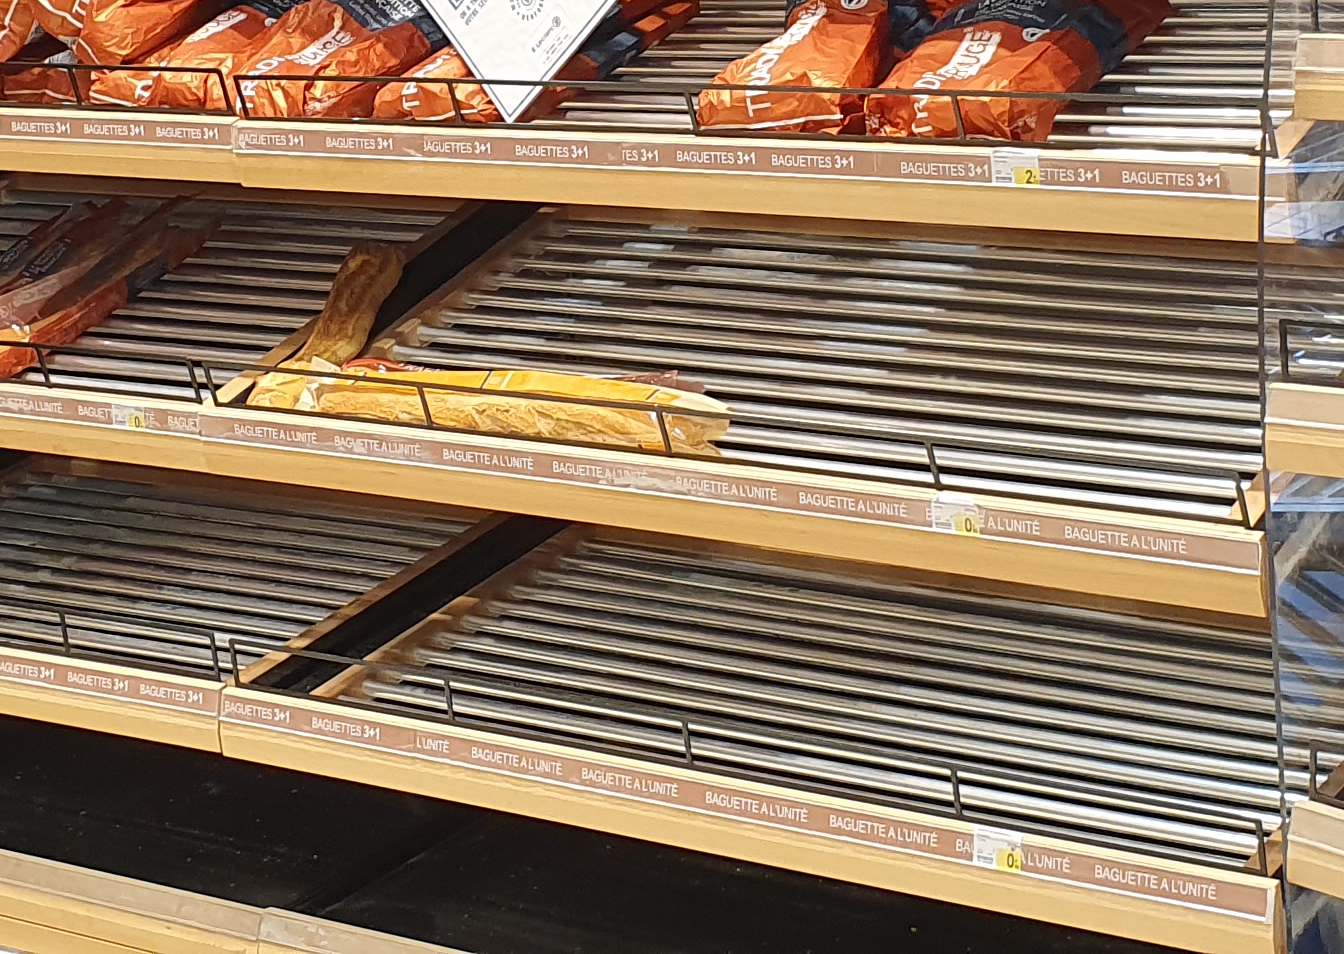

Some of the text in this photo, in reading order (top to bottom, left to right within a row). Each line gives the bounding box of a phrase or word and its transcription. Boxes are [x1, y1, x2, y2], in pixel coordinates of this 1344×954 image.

[377, 138, 394, 150] 3+1
[515, 144, 589, 158] BAGUETTES 3+1
[676, 150, 756, 165] BAGUETTES 3+1
[771, 153, 854, 169] BAGUETTES 3+1
[901, 162, 989, 177] BAGUETTES 3+1
[1122, 171, 1221, 188] BAGUETTES 3+1
[443, 449, 490, 464] BAGUETTE
[799, 492, 856, 511] BAGUETTE
[1064, 526, 1128, 544] BAGUETTE
[1142, 537, 1187, 554] L'UNITÉ
[312, 717, 380, 740] BAGUETTES 3+1
[471, 747, 519, 767] BAGUETTE
[706, 791, 759, 813] BAGUETTE
[829, 814, 886, 837] BAGUETTE
[898, 827, 938, 847] L'UNITÉ
[1095, 864, 1158, 889] BAGUETTE
[1171, 878, 1216, 900] L'UNITÉ
